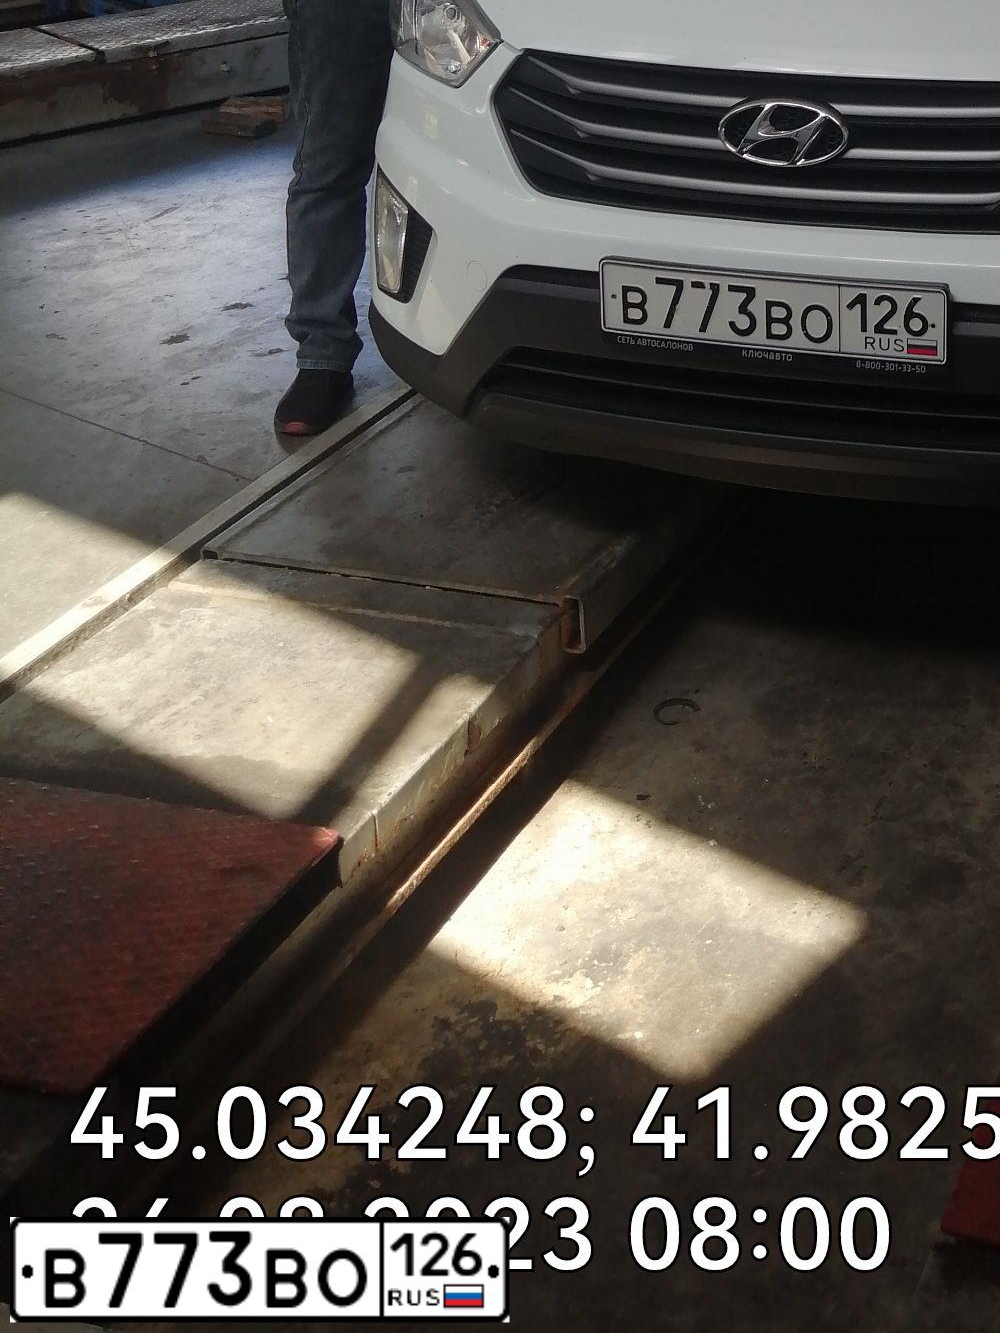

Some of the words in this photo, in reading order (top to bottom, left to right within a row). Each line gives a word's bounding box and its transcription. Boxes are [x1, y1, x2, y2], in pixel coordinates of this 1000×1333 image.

[845, 292, 930, 335] 126
[616, 335, 635, 345] СЕТЬ
[637, 338, 694, 351] АВТОСАЛОНОВ
[863, 336, 906, 353] RUS
